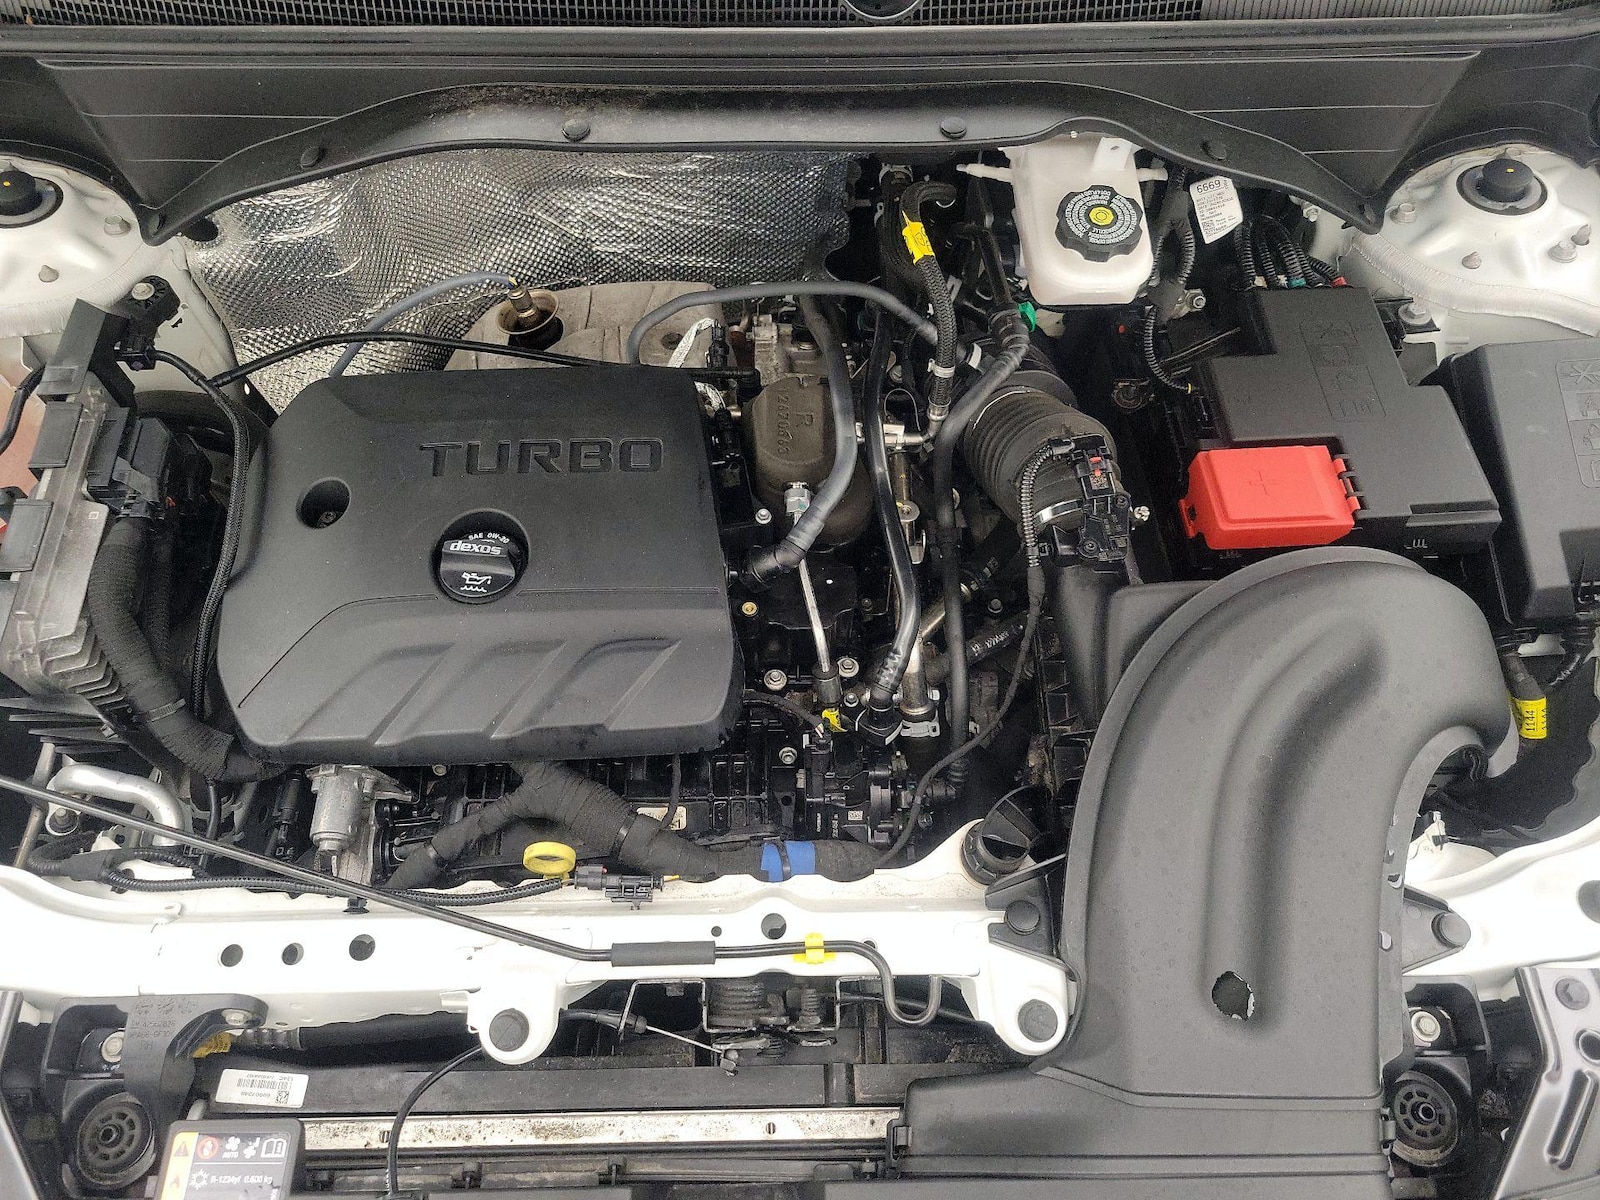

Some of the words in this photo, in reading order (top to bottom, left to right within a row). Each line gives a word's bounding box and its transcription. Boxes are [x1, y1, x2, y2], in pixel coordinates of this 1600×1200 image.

[1196, 179, 1221, 194] 6669
[796, 410, 815, 429] R
[419, 436, 664, 478] TURBO
[468, 532, 484, 541] SAE
[486, 532, 510, 544] 0W-20
[449, 540, 504, 556] dexos
[221, 1151, 239, 1159] AUTO
